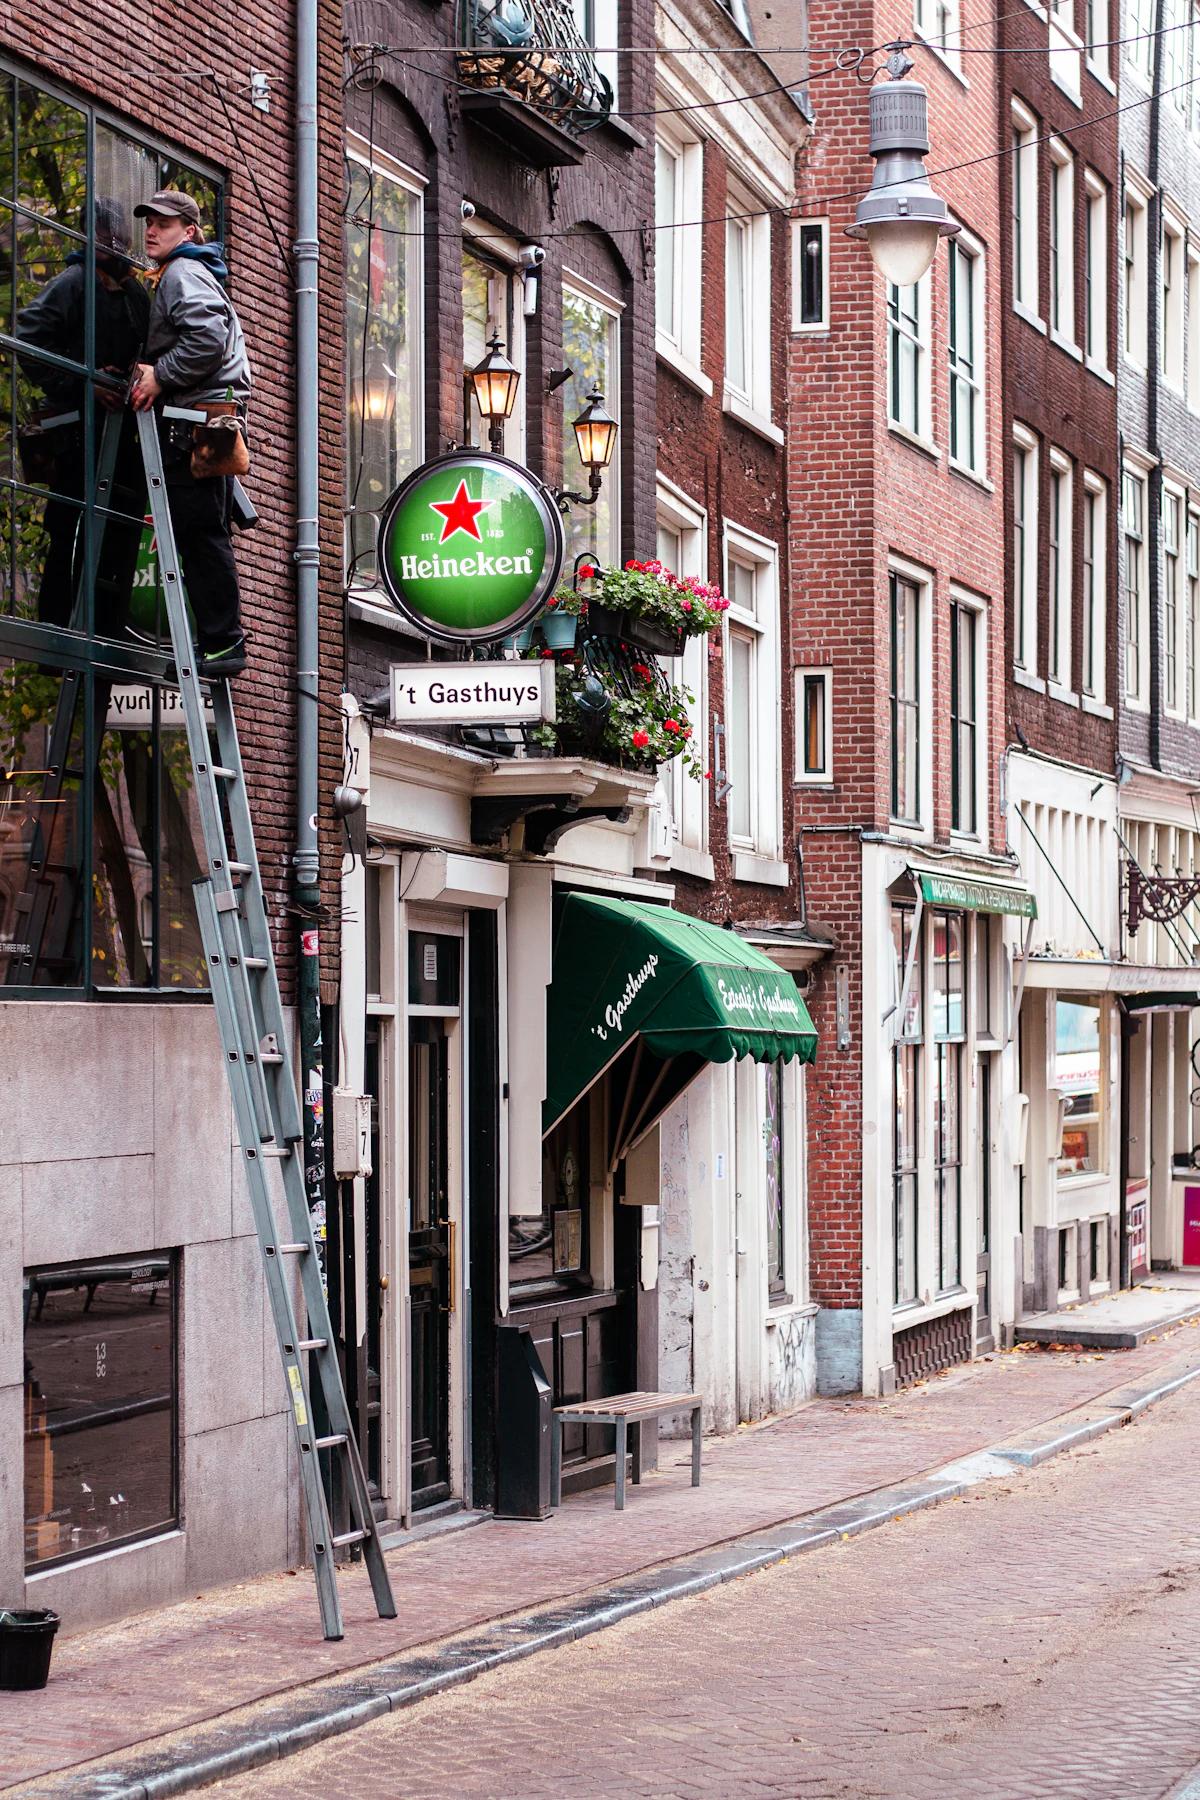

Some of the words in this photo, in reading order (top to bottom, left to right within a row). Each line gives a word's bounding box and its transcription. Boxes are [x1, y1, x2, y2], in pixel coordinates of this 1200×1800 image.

[421, 533, 436, 541] EST.
[486, 529, 504, 538] 1873
[400, 551, 533, 580] Heineken
[399, 684, 416, 704] 't
[428, 682, 539, 706] Gasthuys
[353, 747, 359, 775] 7
[2, 943, 17, 953] THREE
[591, 1023, 607, 1041] 't
[604, 953, 659, 1032] Gasthuys
[759, 984, 799, 1022] Gasthuys
[361, 1130, 367, 1156] 7
